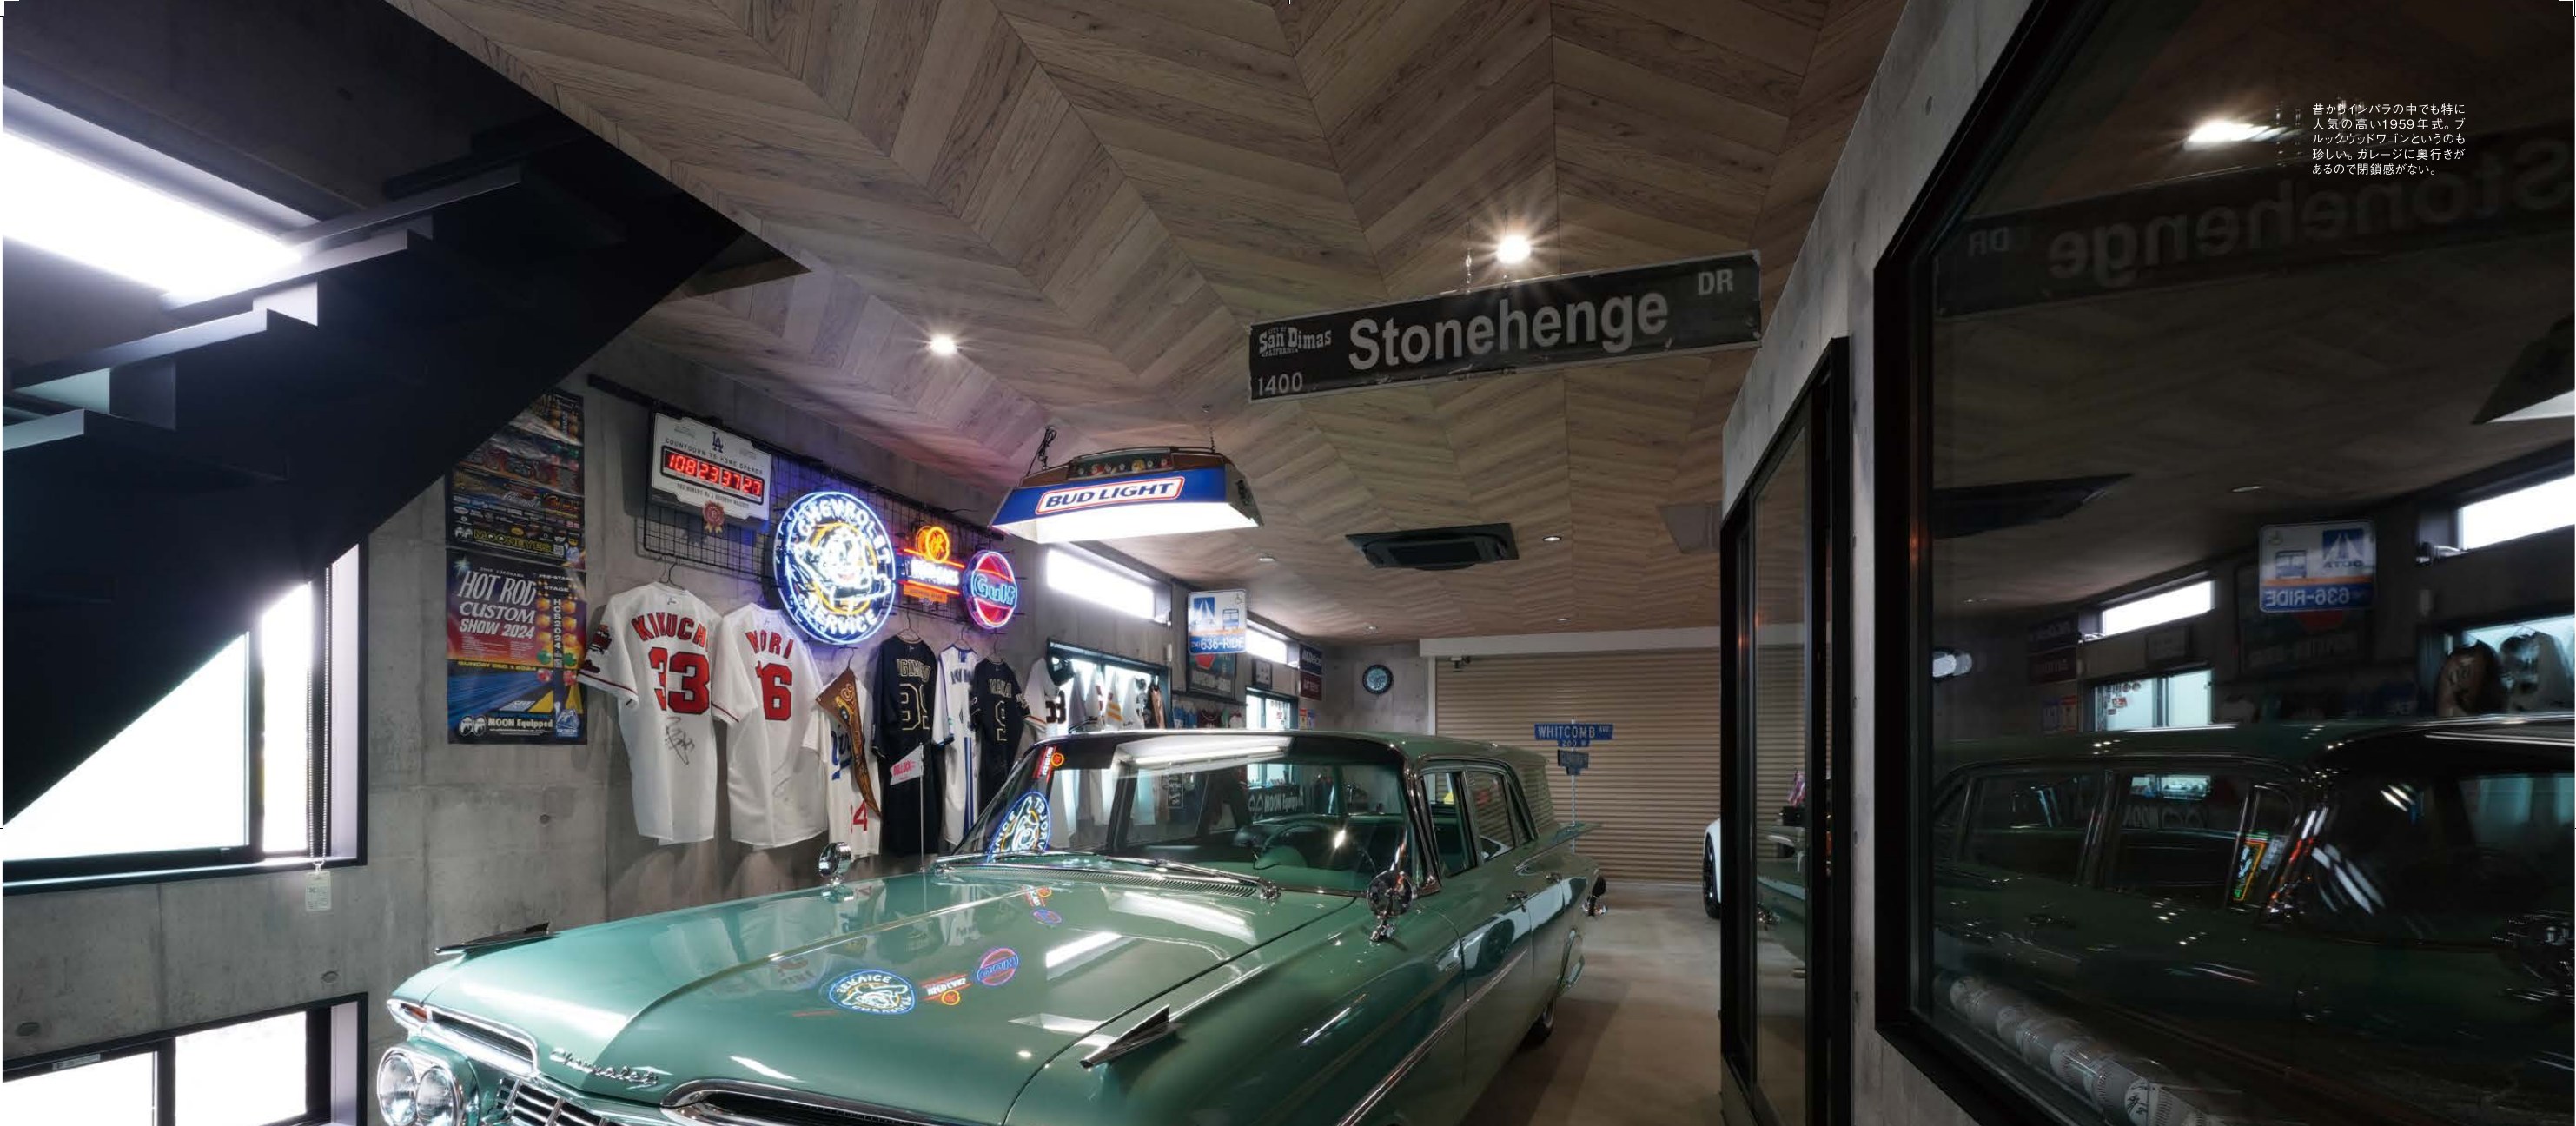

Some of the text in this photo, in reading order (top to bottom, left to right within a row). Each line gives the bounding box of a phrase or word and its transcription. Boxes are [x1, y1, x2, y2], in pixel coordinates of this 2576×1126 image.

[1697, 268, 1734, 296] DR
[1259, 327, 1333, 355] San Dimas
[1348, 292, 1668, 371] Stonehenge
[1258, 372, 1303, 396] 1400
[1044, 482, 1175, 508] BUD LIGHT
[457, 570, 537, 606] HOT ROD
[974, 573, 1016, 606] Gulf
[459, 601, 536, 624] CUSTOM
[797, 593, 878, 635] SERVICE
[459, 619, 536, 639] SHOW 2024
[487, 718, 553, 730] MOON Equipped
[1538, 725, 1596, 739] WHITCOMB
